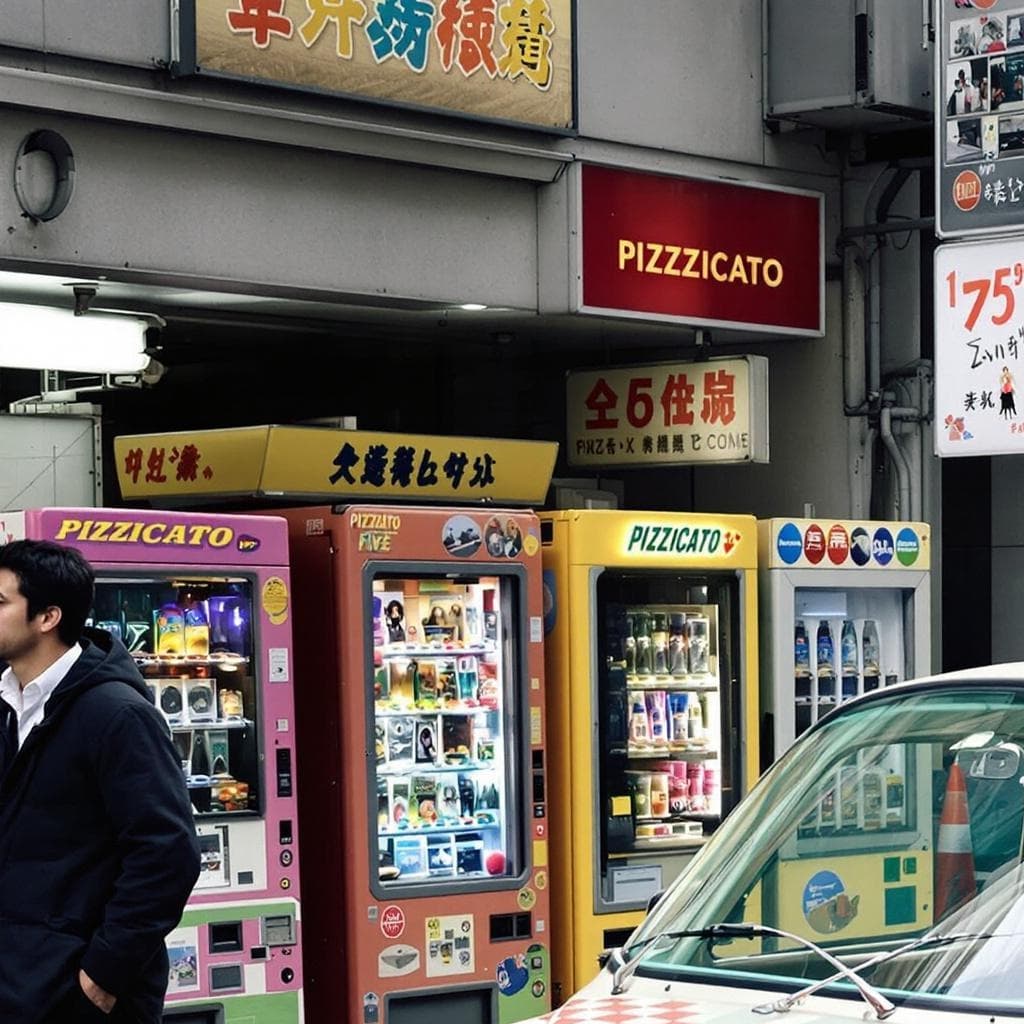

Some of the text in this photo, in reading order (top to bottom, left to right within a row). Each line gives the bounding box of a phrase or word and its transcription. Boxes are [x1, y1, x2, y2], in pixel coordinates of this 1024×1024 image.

[618, 239, 784, 288] PIZZZICATO
[55, 519, 234, 548] PIZZICATO
[627, 525, 721, 554] PIZZICATO
